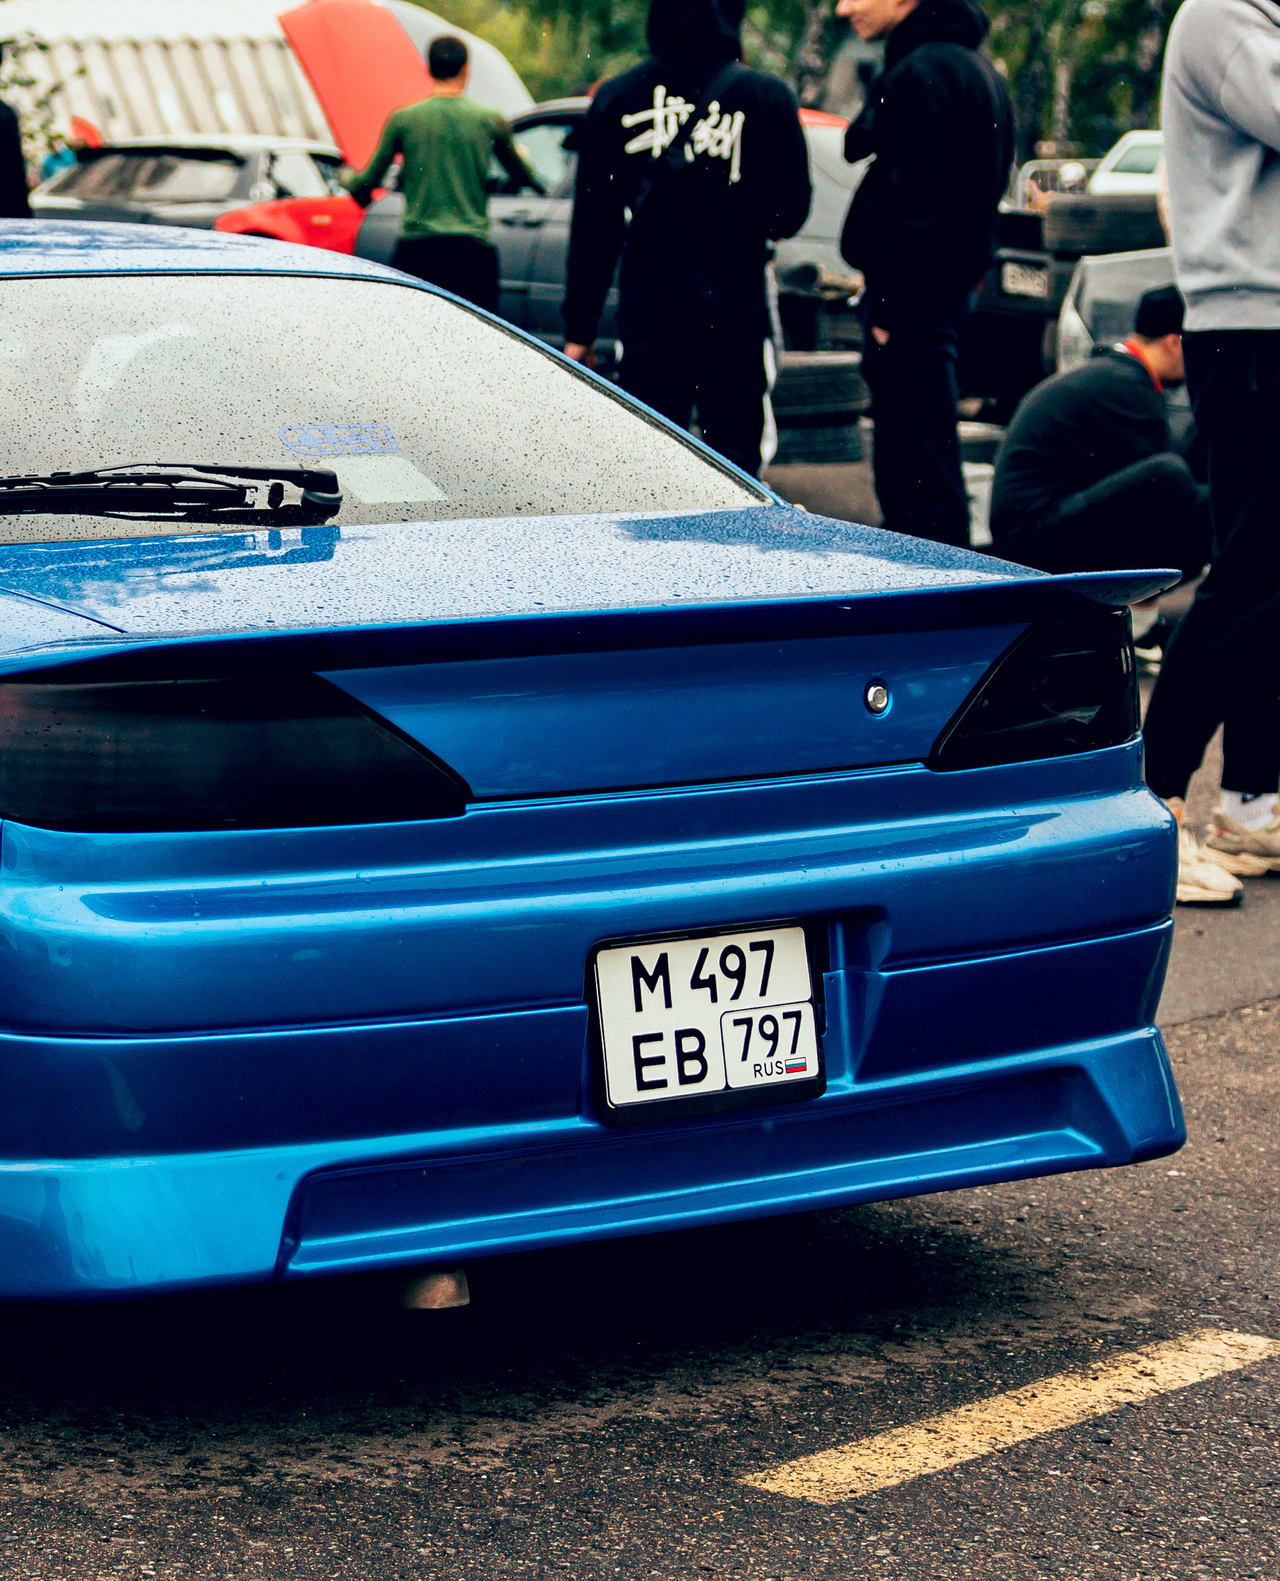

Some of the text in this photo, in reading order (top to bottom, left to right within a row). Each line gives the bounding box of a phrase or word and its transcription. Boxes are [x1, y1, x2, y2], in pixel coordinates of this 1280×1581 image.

[631, 939, 774, 1012] M 497
[632, 1028, 708, 1091] EB
[733, 1010, 802, 1062] 797
[753, 1061, 784, 1078] RUS
